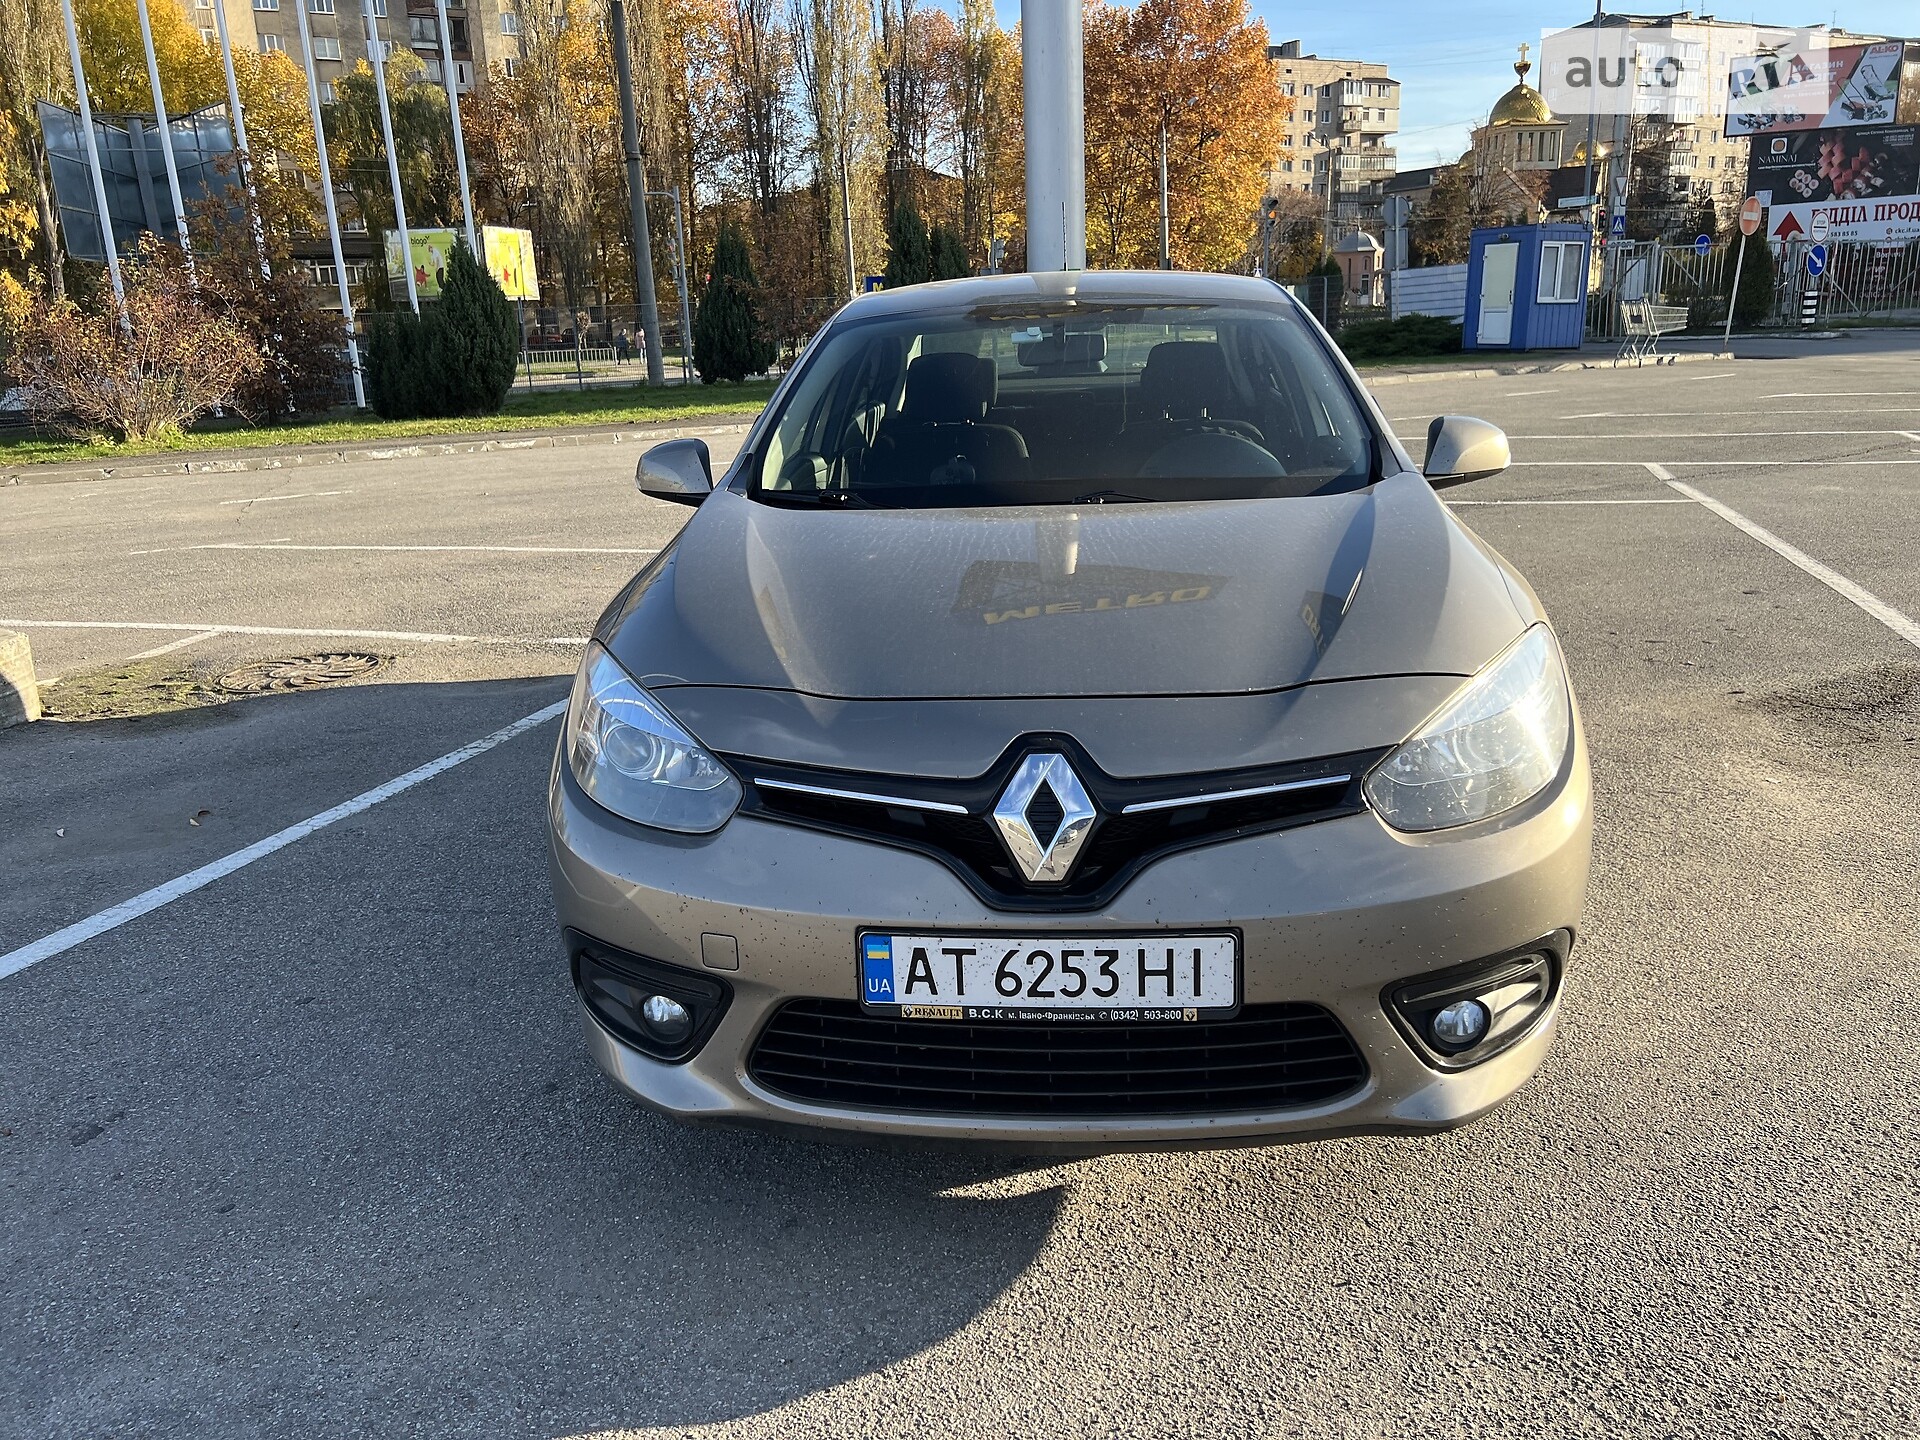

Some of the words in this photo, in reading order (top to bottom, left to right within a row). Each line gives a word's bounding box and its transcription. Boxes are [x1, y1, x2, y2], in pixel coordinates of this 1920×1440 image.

[1870, 45, 1899, 54] AL-KO
[1758, 154, 1797, 164] NAMINAJ
[905, 947, 977, 996] AT
[994, 949, 1120, 998] 6253
[1137, 948, 1202, 997] HI
[868, 978, 892, 993] UA
[914, 1007, 961, 1018] RENAULT
[1110, 1009, 1139, 1021] (0342)
